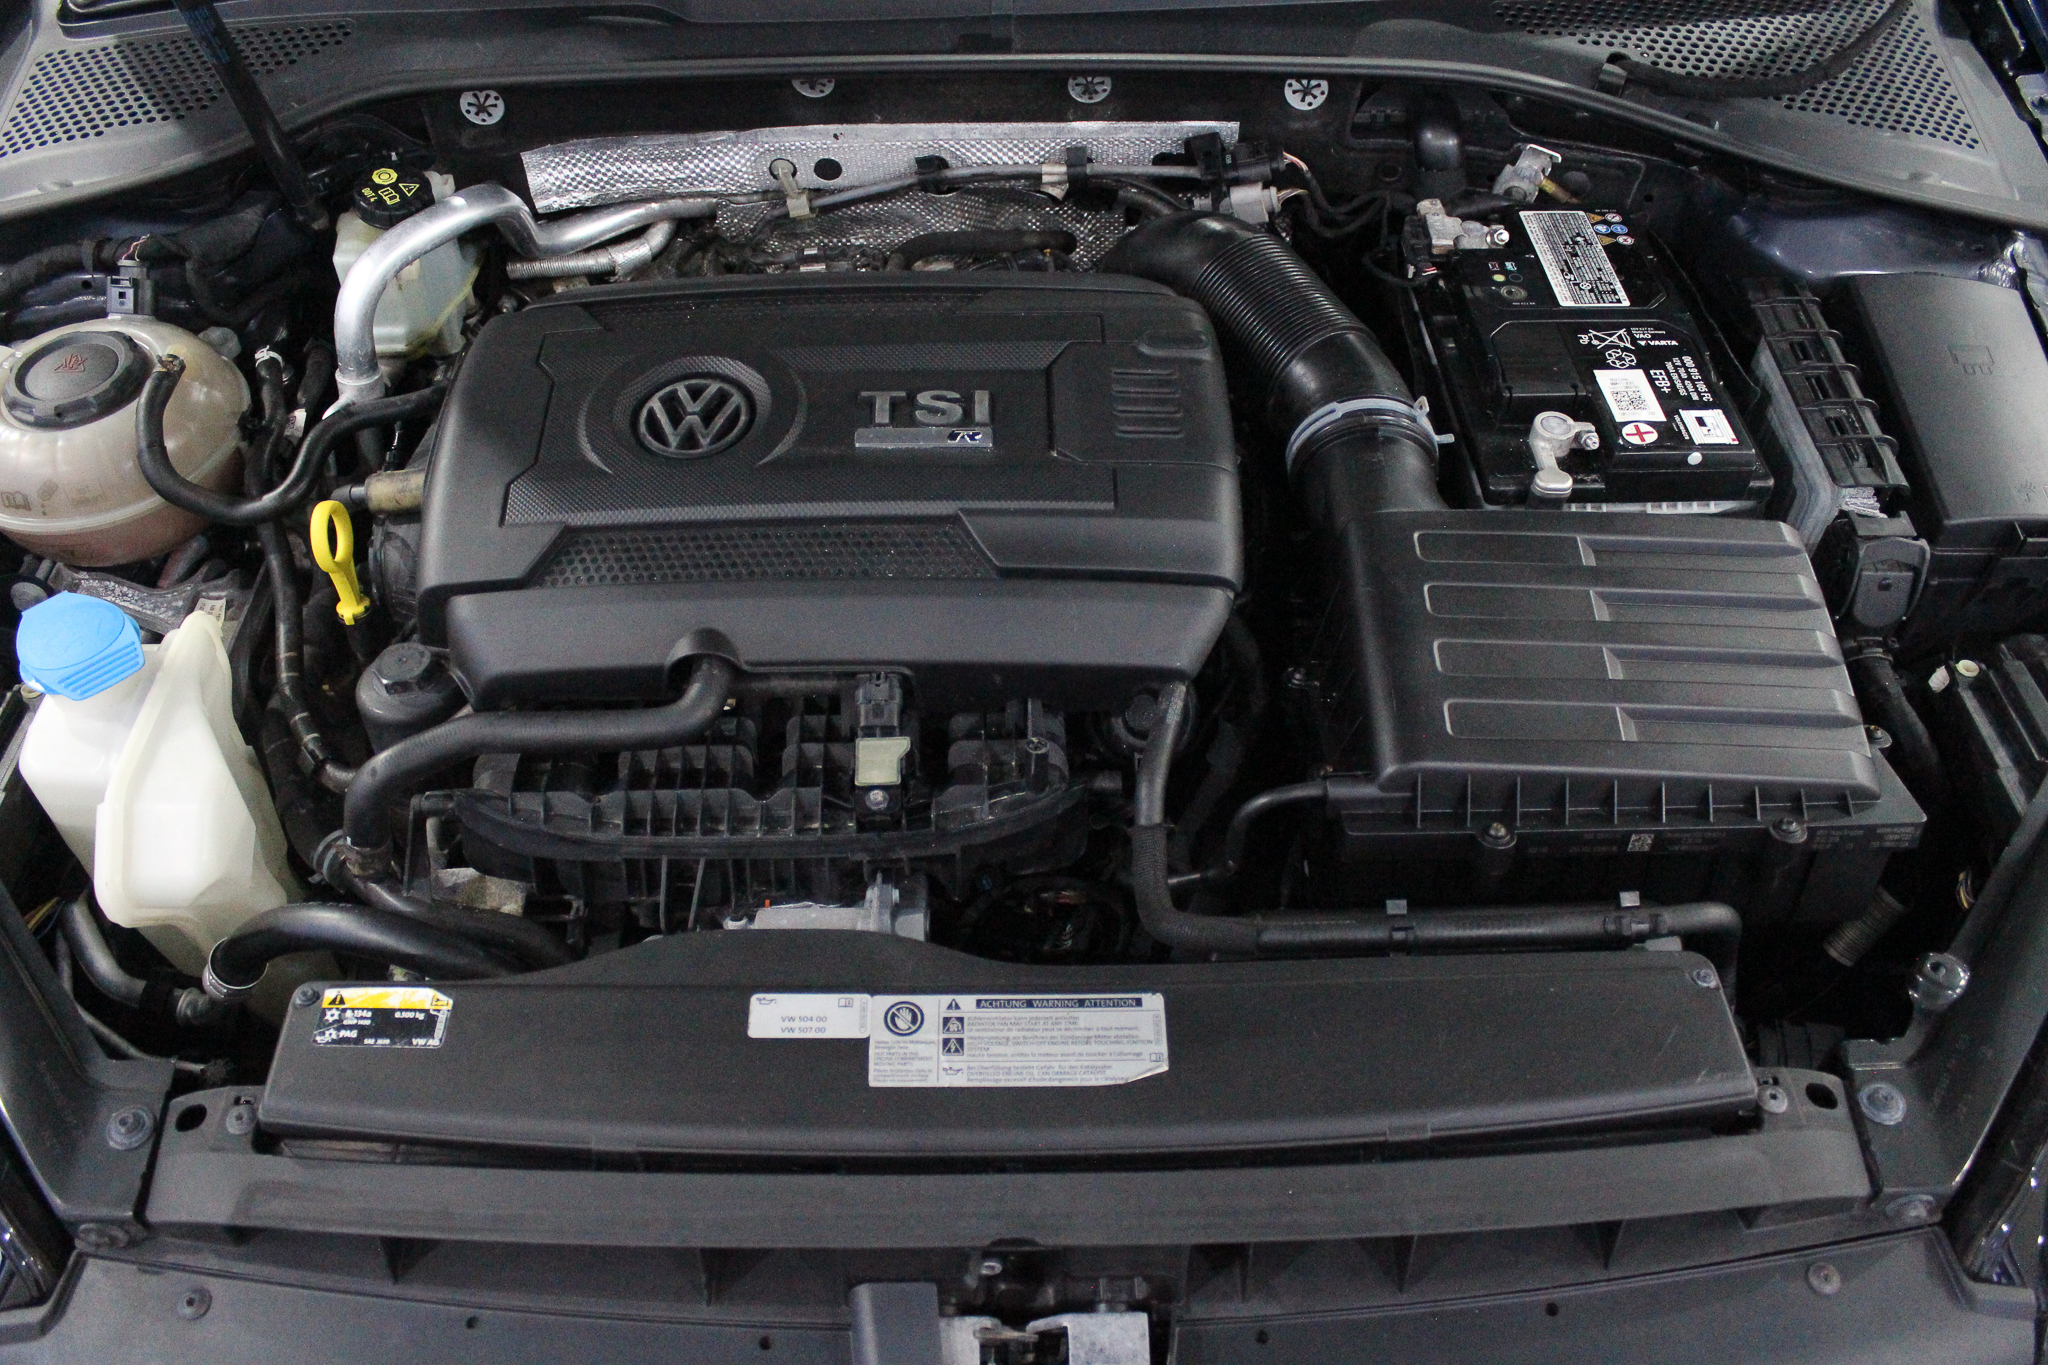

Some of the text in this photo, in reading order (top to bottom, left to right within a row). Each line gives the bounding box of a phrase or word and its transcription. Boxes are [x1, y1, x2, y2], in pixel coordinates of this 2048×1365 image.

[1578, 335, 1590, 344] Pb
[1682, 356, 1695, 368] 000
[1688, 367, 1701, 380] 915
[1650, 370, 1671, 393] EFB+
[1701, 393, 1713, 402] FC
[859, 390, 991, 428] TSI
[946, 430, 984, 443] R
